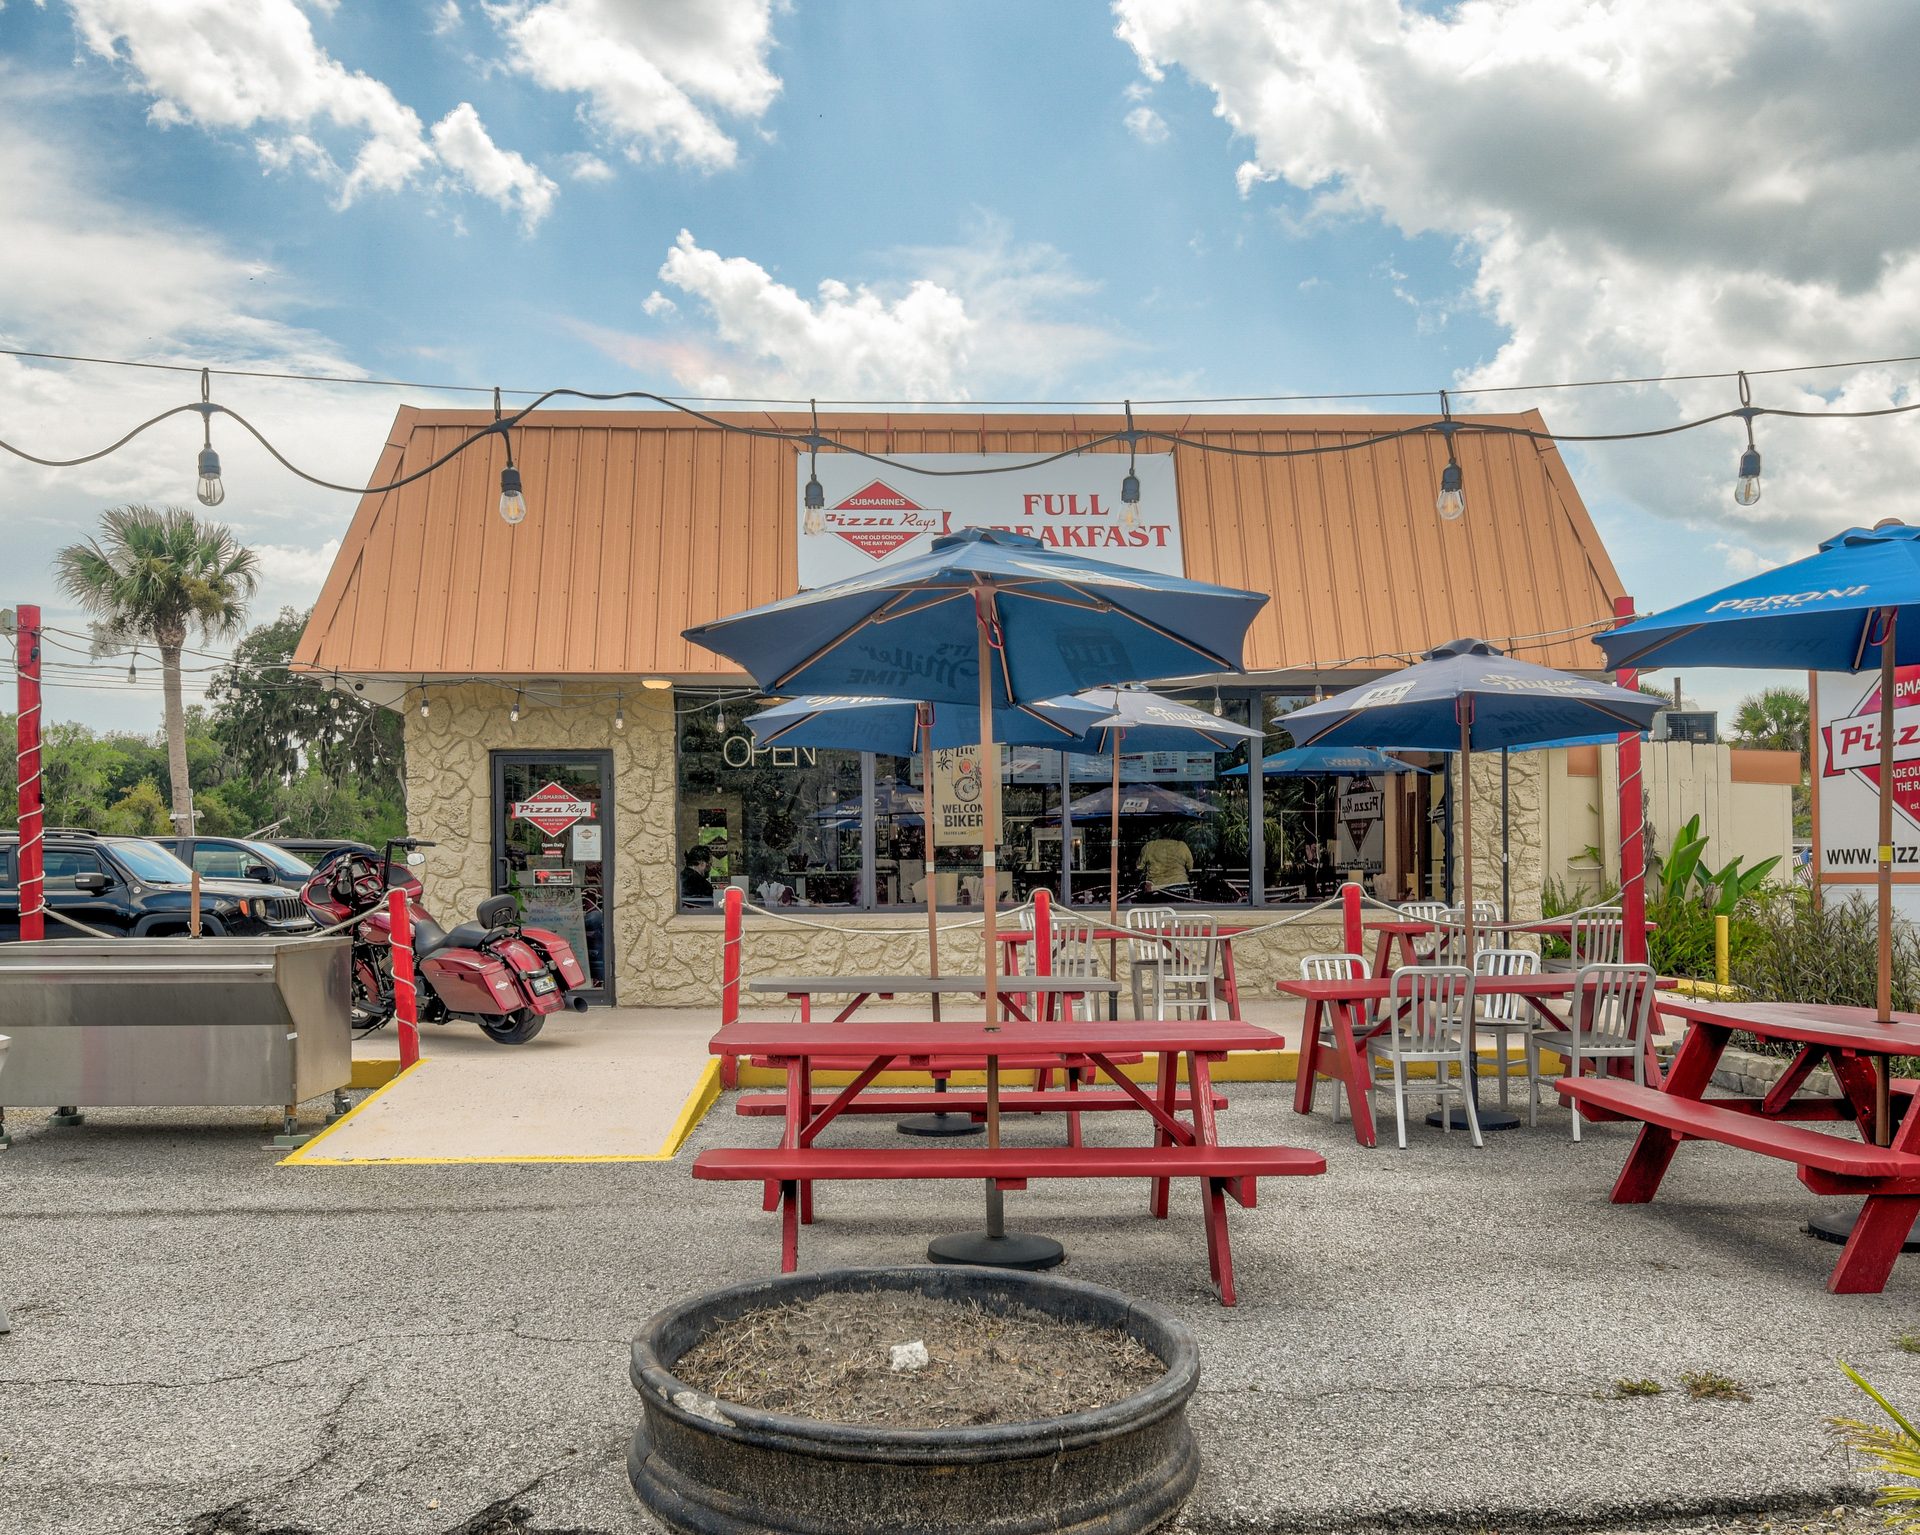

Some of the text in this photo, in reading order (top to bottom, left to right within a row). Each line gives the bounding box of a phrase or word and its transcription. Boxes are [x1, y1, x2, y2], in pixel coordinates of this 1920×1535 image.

[849, 498, 906, 506] SUBMARINES
[1023, 494, 1110, 516] FULL
[824, 512, 936, 531] Pizza Rays
[1705, 585, 1871, 613] PERONI
[1908, 765, 1920, 777] OL
[1896, 781, 1912, 792] THE
[520, 803, 588, 815] Pizza Rays
[942, 804, 983, 814] WELCO
[944, 815, 983, 828] BIKER
[1827, 842, 1920, 865] www.izz
